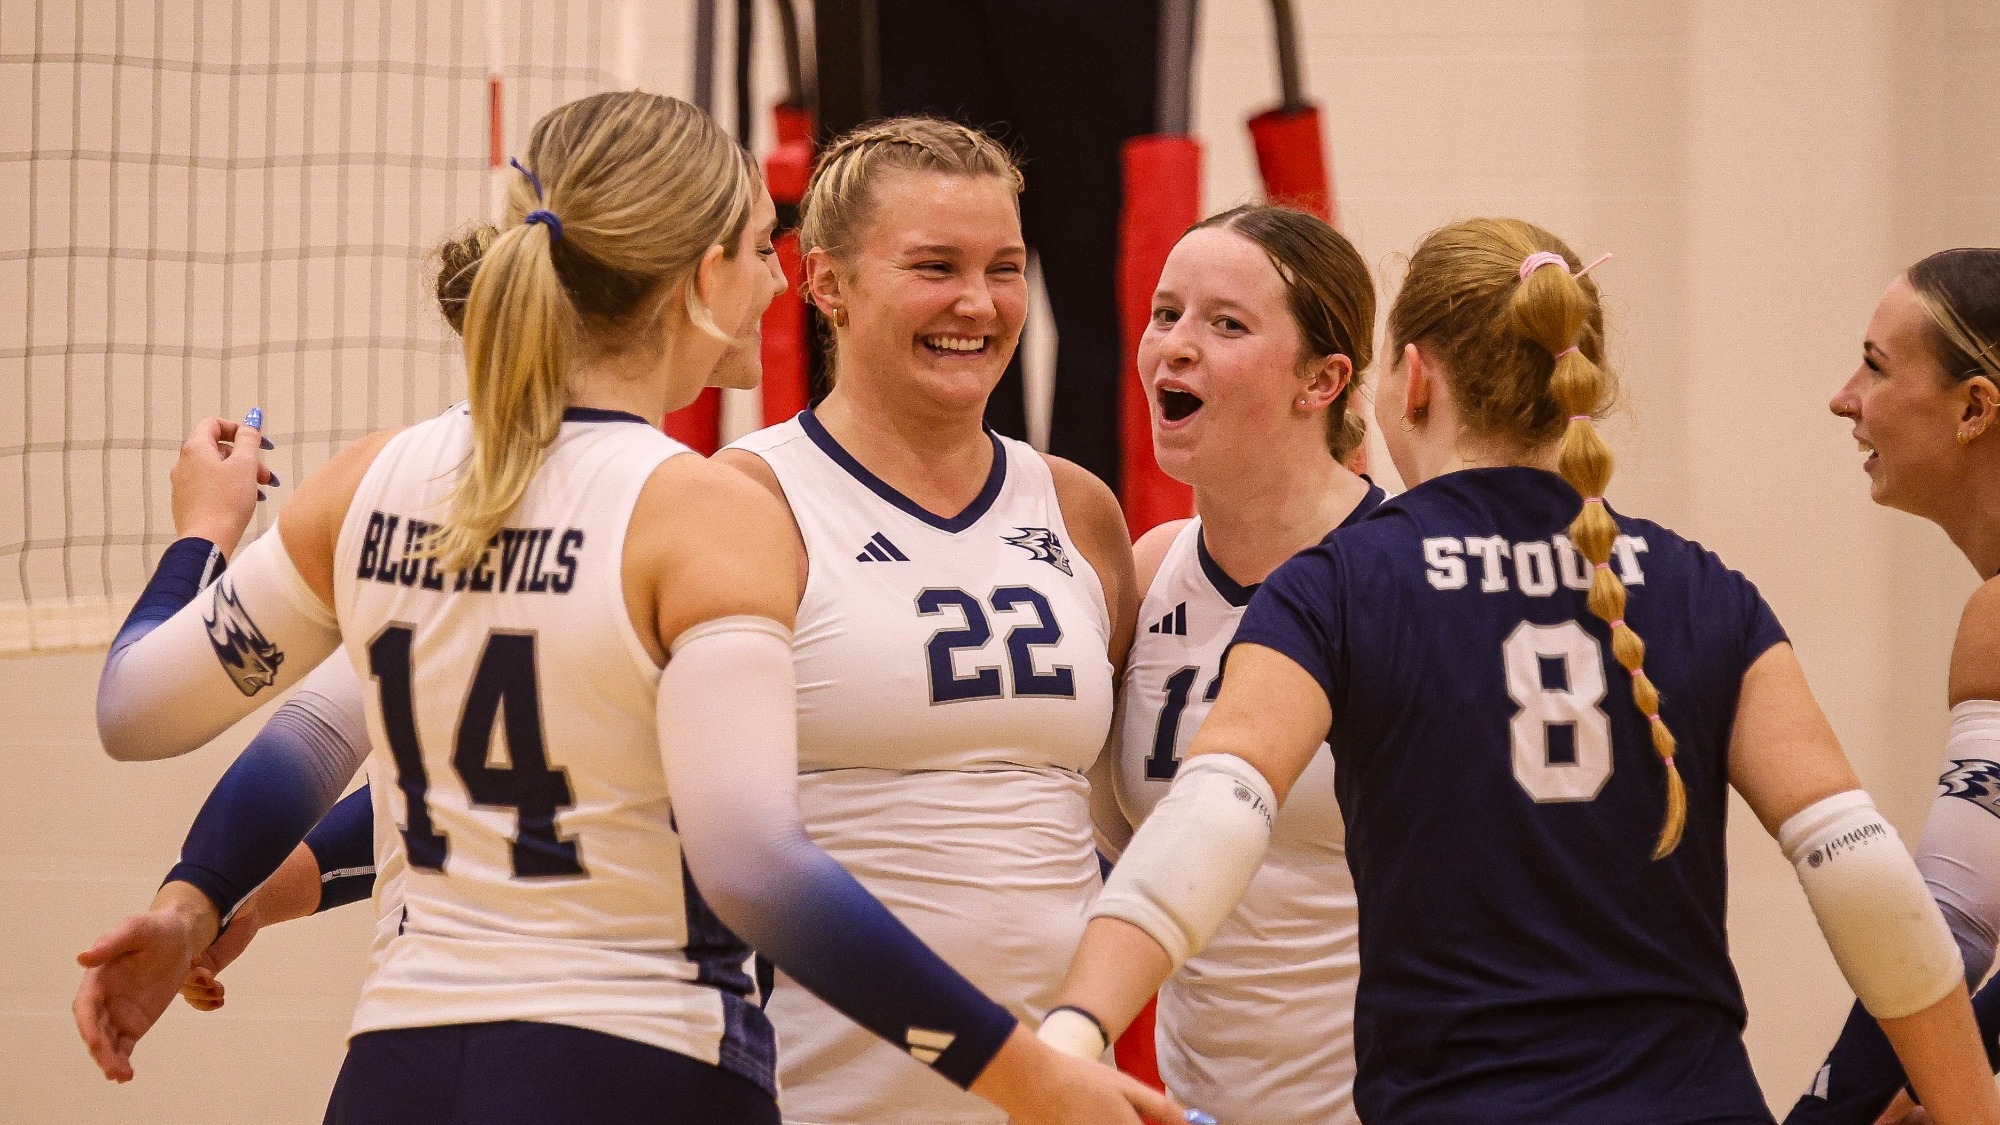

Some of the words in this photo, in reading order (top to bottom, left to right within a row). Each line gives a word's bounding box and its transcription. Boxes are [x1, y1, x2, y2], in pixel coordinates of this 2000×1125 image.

[453, 526, 585, 596] EVILS
[913, 583, 1077, 707] 22
[364, 619, 591, 880] 14
[1144, 664, 1224, 782] 1
[1502, 618, 1615, 804] 8
